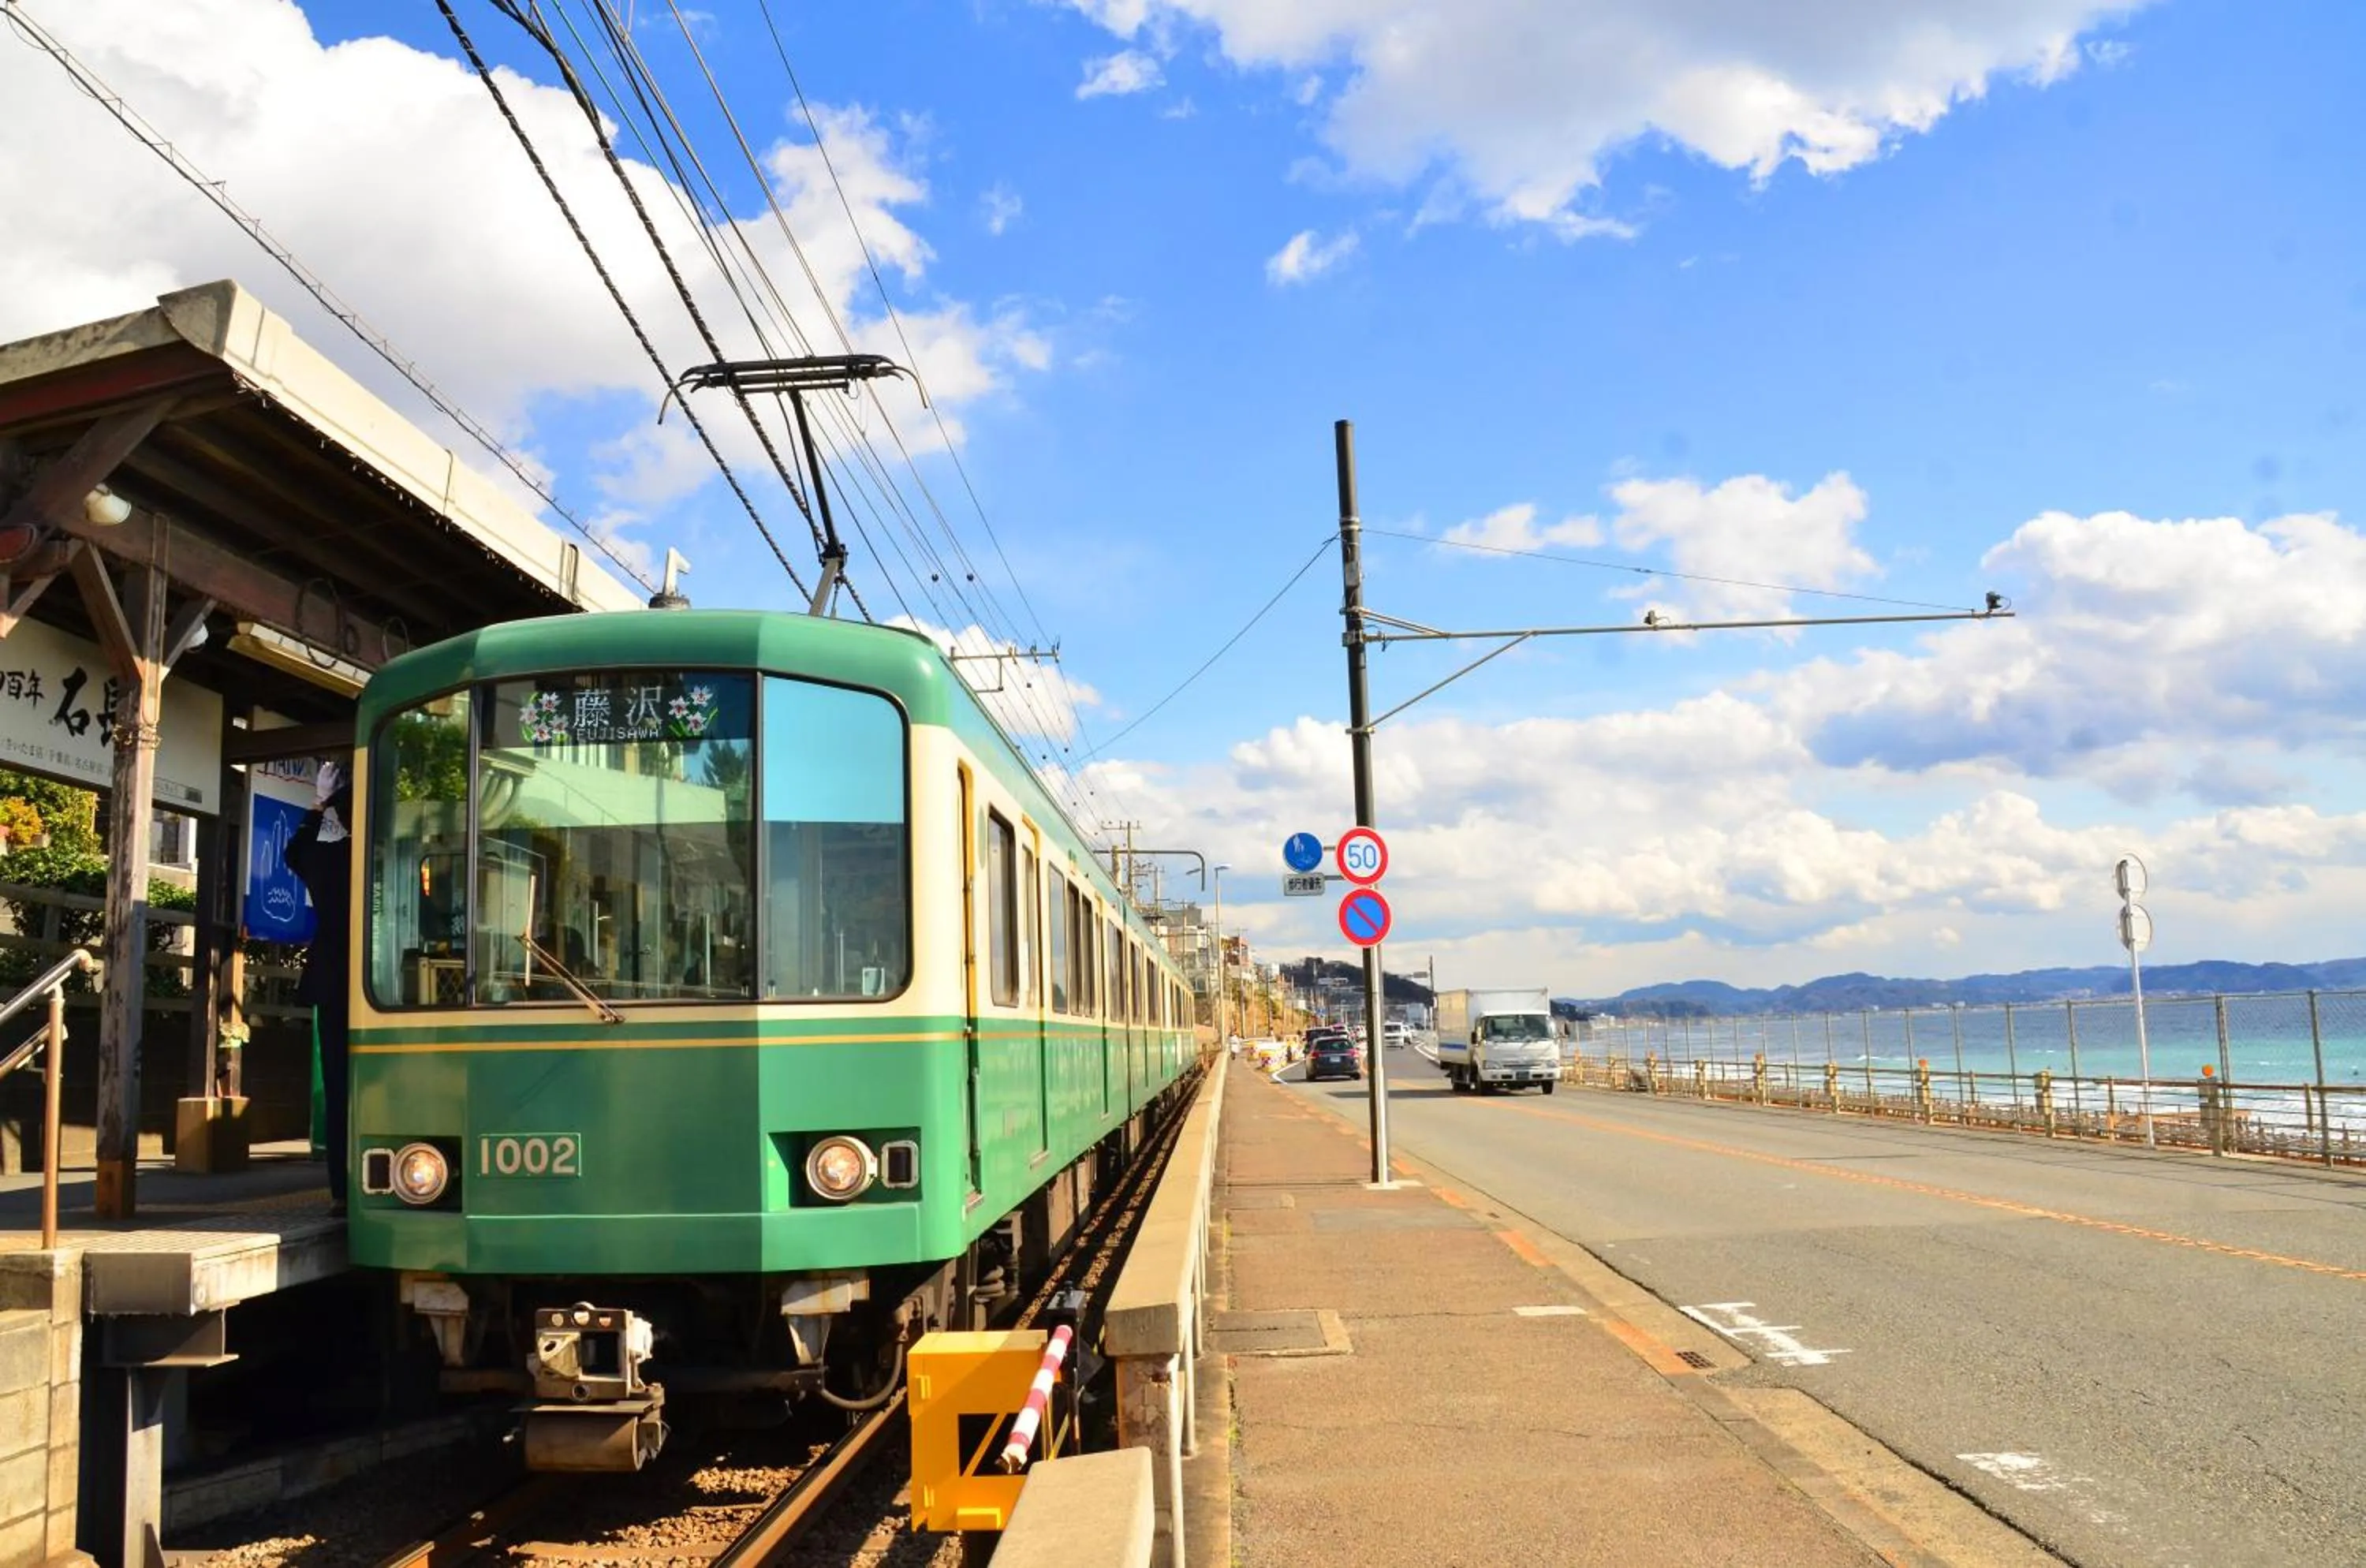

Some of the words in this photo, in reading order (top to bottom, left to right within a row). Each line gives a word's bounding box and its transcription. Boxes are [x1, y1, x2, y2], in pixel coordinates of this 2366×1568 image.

[0, 668, 45, 709] 百年
[573, 685, 662, 728] 藤沢
[577, 726, 659, 741] FUJISAWA
[1348, 844, 1376, 868] 50
[481, 1137, 576, 1174] 1002
